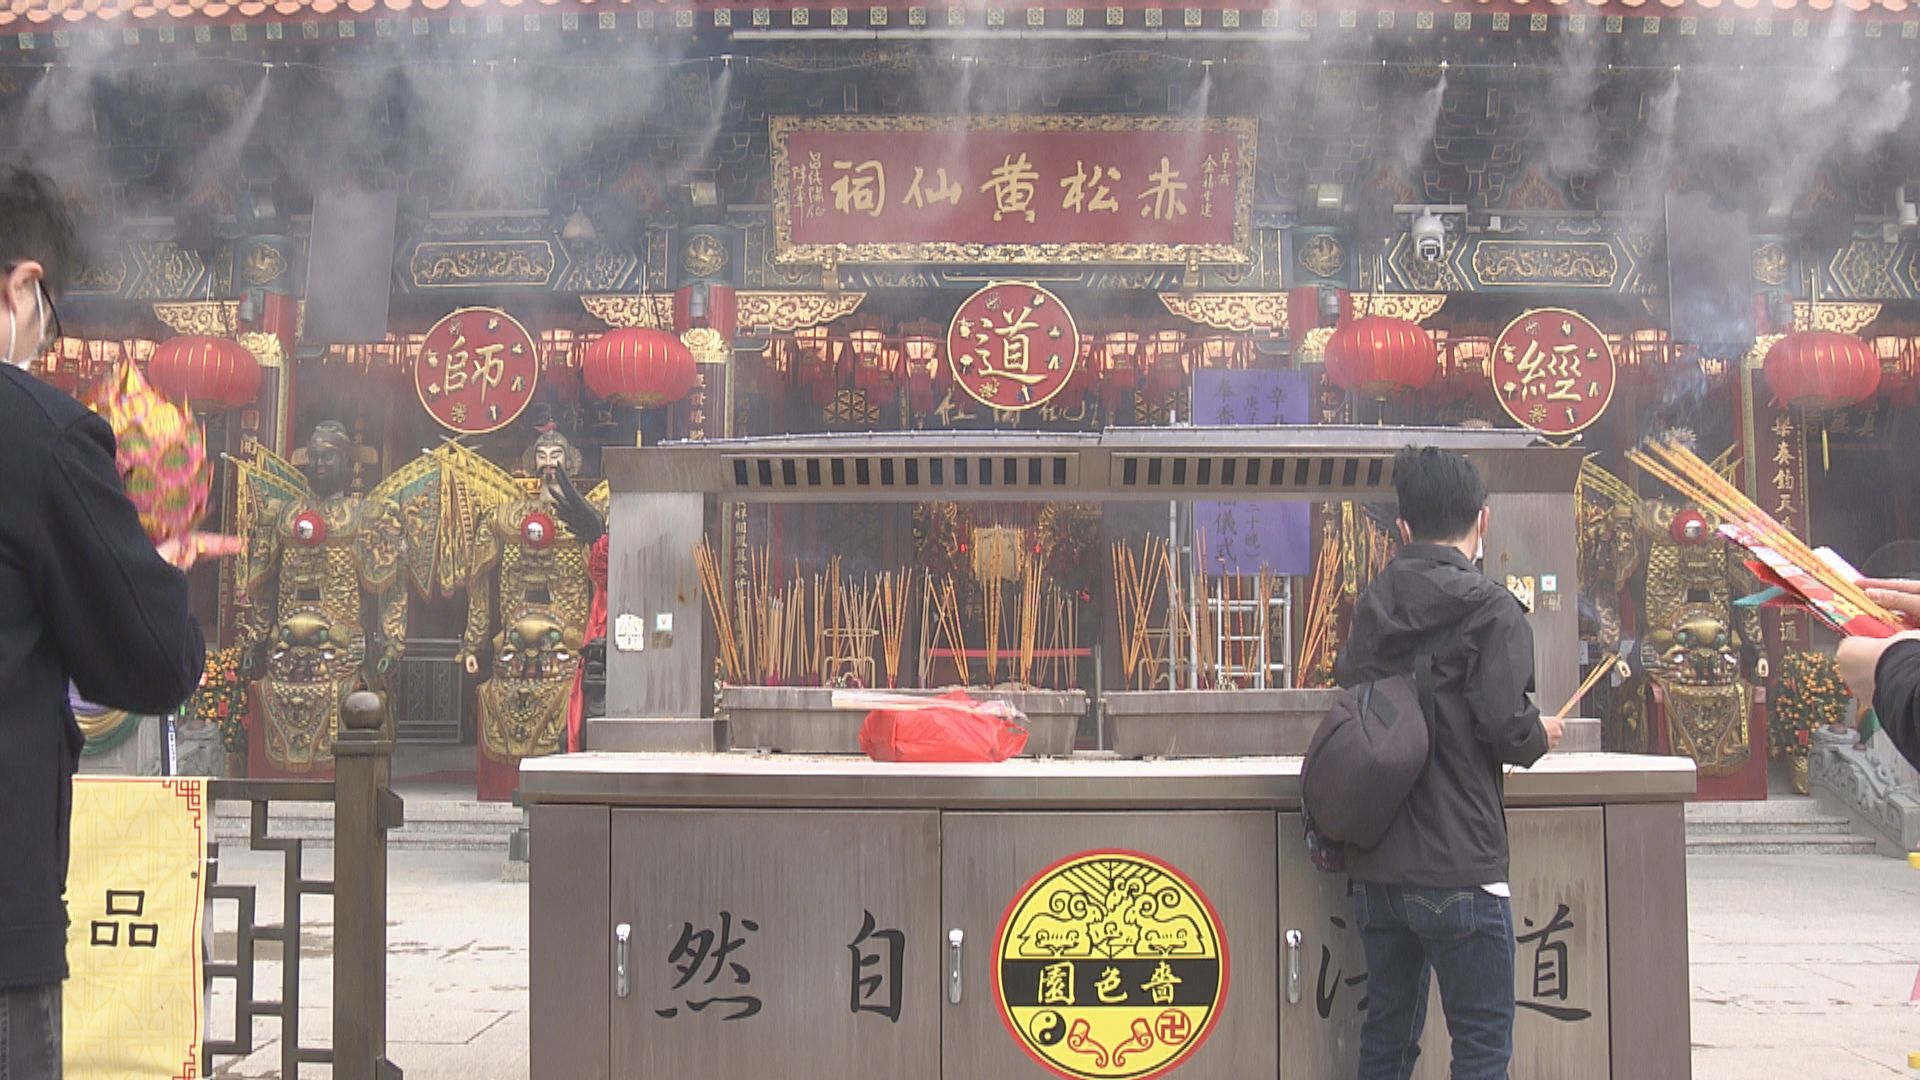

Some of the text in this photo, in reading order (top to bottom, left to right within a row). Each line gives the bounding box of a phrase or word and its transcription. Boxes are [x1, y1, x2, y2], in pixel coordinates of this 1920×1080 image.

[443, 335, 504, 405] 師
[974, 306, 1047, 384] 道
[1515, 339, 1583, 403] 經
[90, 889, 159, 948] 品
